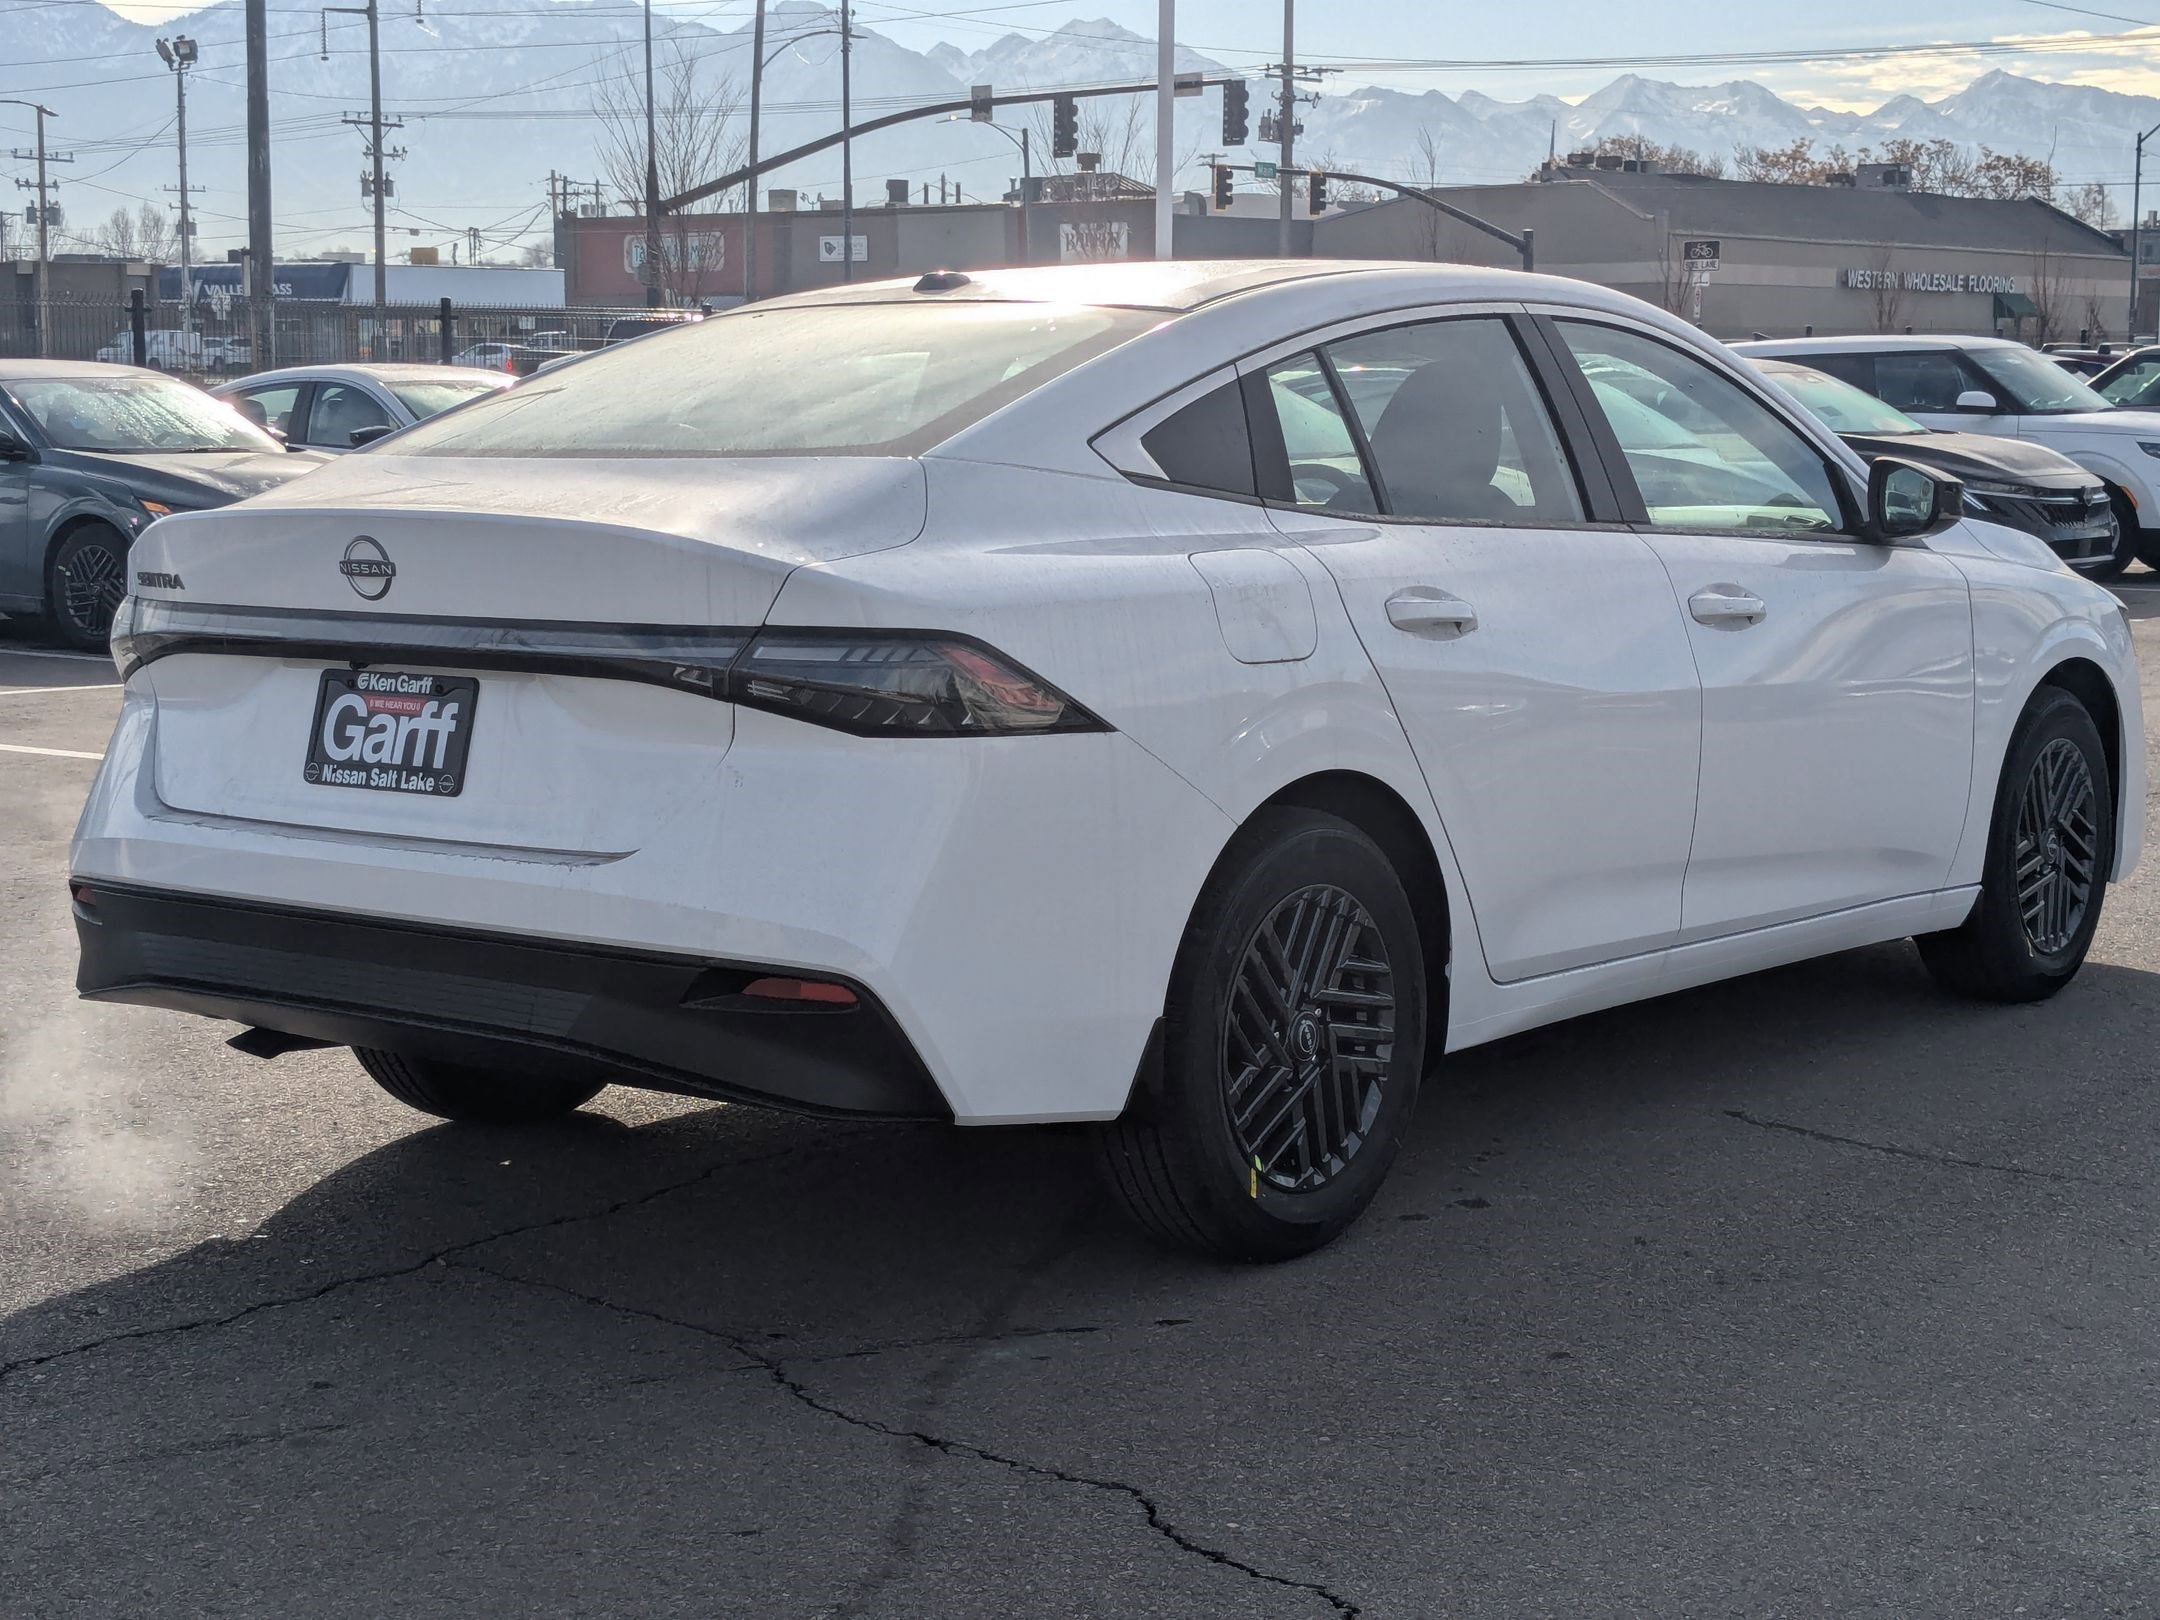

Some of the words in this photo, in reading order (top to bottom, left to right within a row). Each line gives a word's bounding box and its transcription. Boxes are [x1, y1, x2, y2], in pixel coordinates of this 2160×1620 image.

[1701, 260, 1717, 269] LANE
[1847, 269, 1899, 289] WESTERN
[1903, 272, 1964, 292] WHOLESALE
[1968, 275, 2016, 294] FLOORING
[340, 563, 392, 575] NISSAN
[368, 673, 396, 692] Ken
[397, 675, 434, 695] Garff
[386, 701, 403, 710] HEAR
[403, 702, 417, 711] YOU
[323, 693, 459, 769] Garff
[321, 764, 367, 785] Nissan
[370, 768, 398, 788] Salt
[400, 771, 435, 792] Lake
